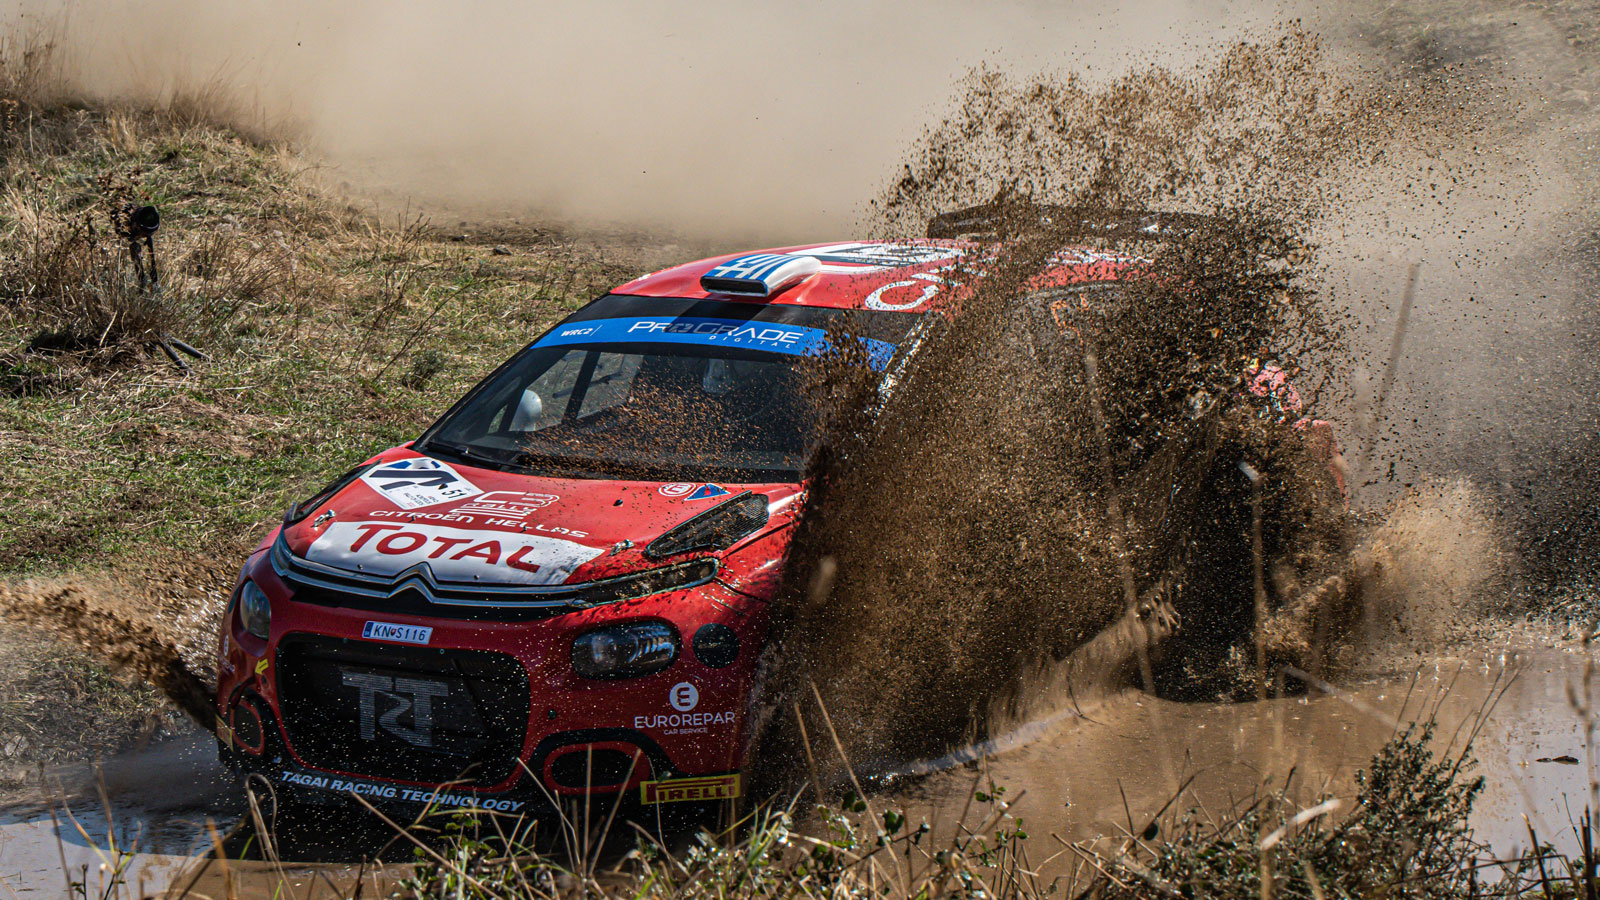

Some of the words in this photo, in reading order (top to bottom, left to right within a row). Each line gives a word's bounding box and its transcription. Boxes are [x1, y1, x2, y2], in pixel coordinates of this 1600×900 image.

[561, 328, 594, 337] WRC2
[709, 335, 791, 349] DIGITAL
[441, 489, 467, 499] 51
[484, 517, 589, 538] HELLAS
[349, 524, 541, 573] TOTAL
[634, 711, 736, 729] EUROREPAR
[679, 727, 708, 735] SERVICE
[281, 771, 329, 788] TAGAI
[330, 780, 397, 798] RACING
[401, 789, 525, 812] TECHNOLOGY
[646, 777, 736, 803] PIRELLI
